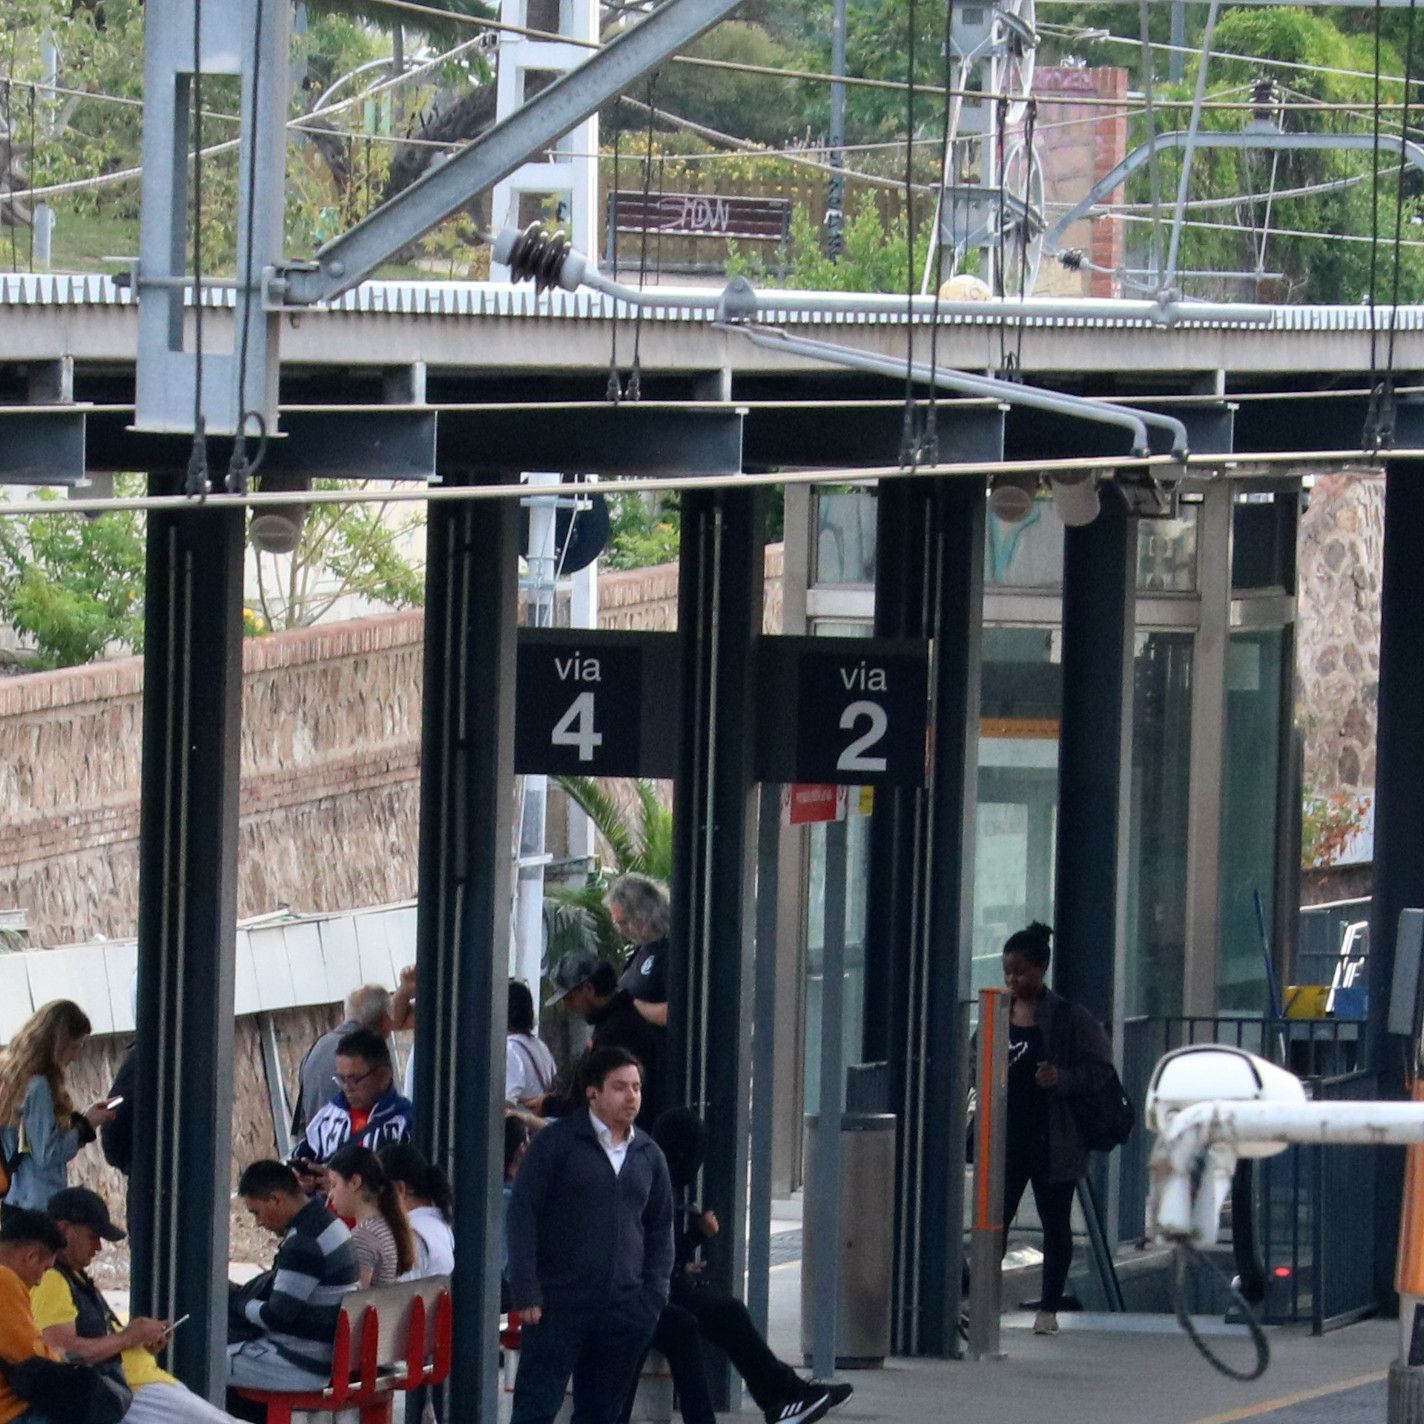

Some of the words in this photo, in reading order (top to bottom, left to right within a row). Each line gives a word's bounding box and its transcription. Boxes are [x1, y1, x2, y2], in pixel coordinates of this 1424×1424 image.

[554, 650, 602, 682] via
[839, 660, 888, 691] via
[551, 691, 602, 761] 4
[836, 700, 887, 771] 2
